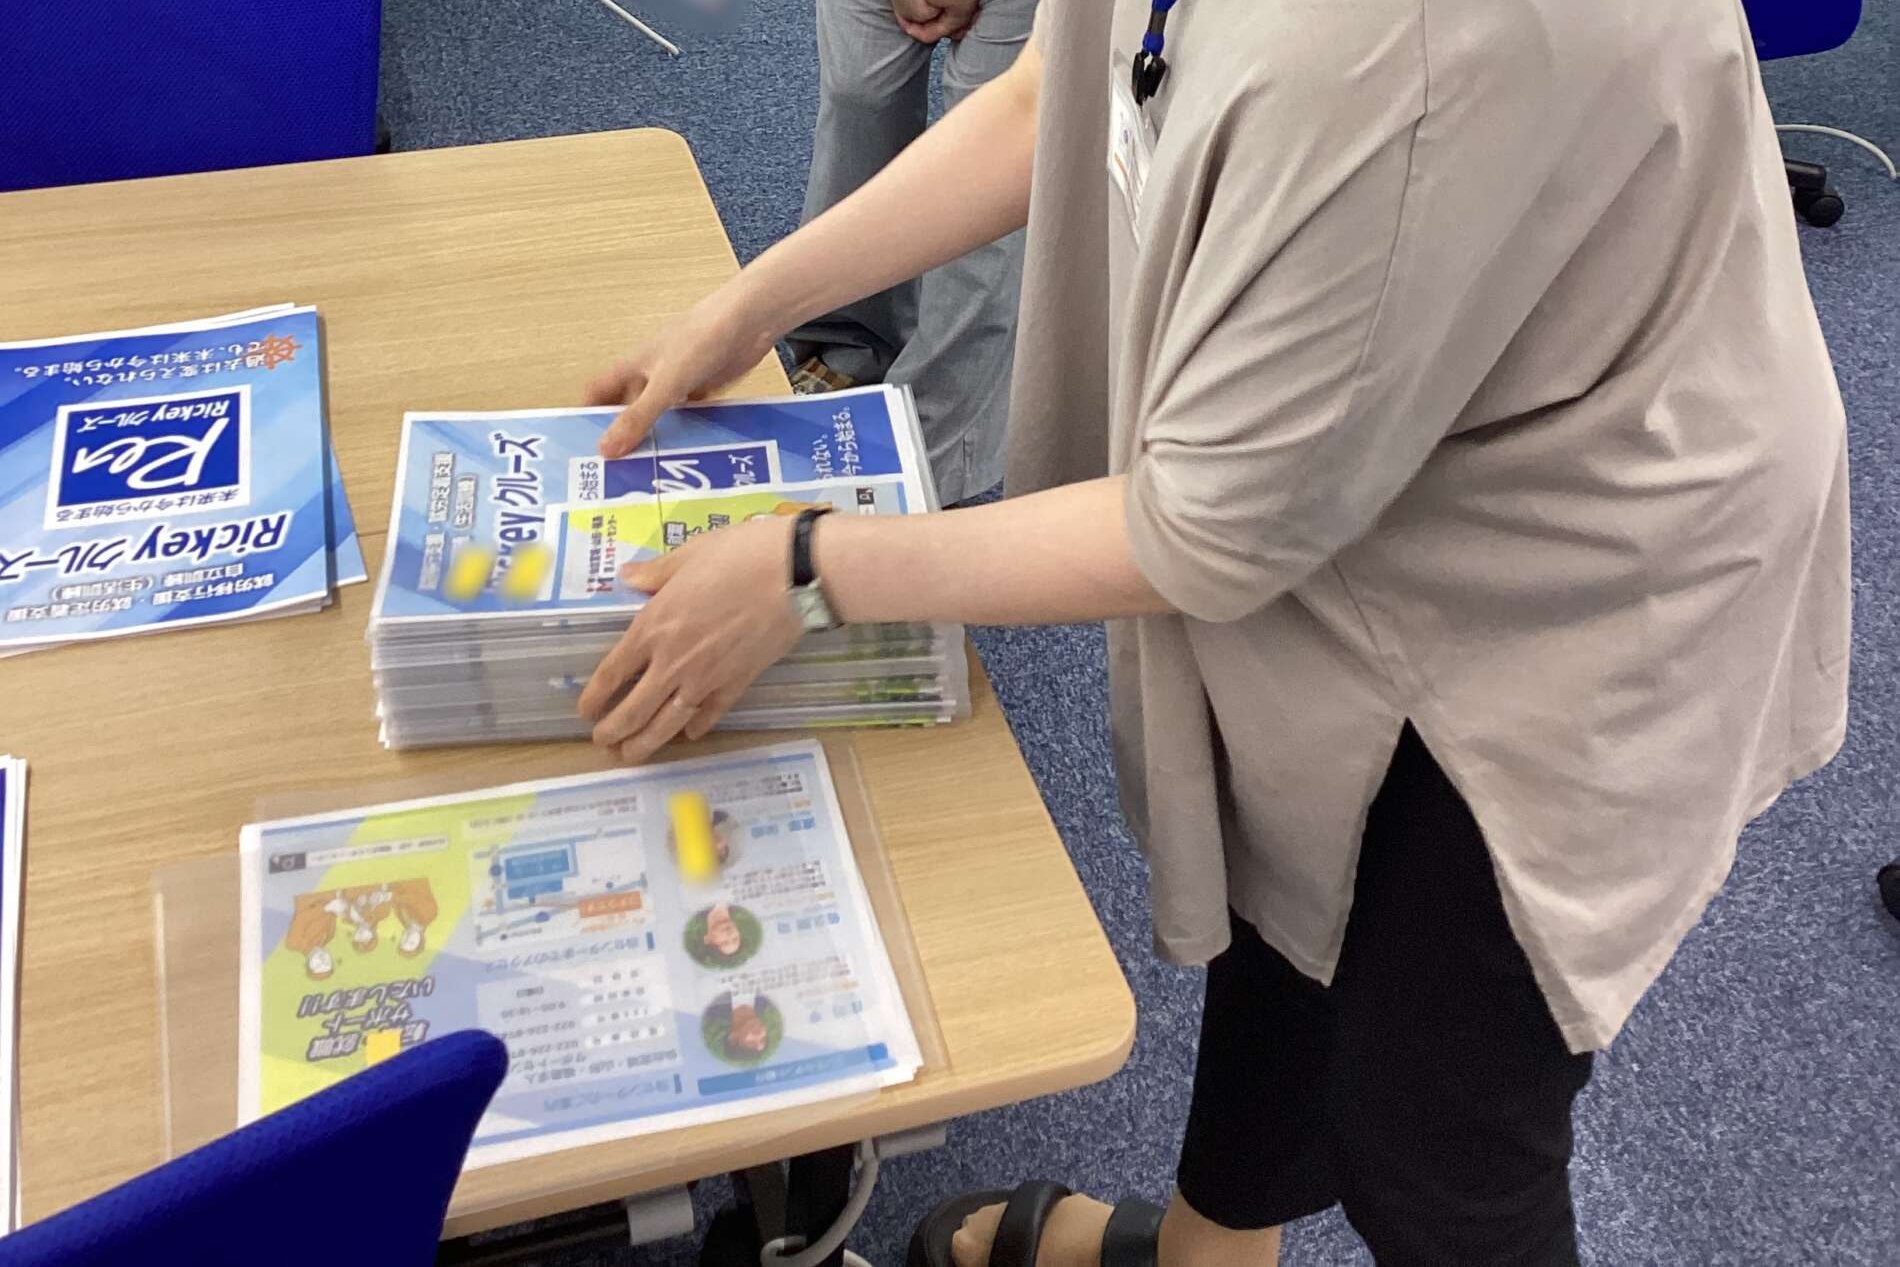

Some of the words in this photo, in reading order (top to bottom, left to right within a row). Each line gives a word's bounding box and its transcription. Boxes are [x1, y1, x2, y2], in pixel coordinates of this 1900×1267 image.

[14, 341, 264, 378] でも、未来は今から始まる。
[64, 354, 264, 387] 過去は変えられない。
[77, 409, 148, 433] クルーズ
[151, 400, 229, 423] Rickey
[493, 433, 542, 506] クルーズ
[55, 488, 239, 523] 未来は今から始まる
[132, 514, 287, 562] Rickey
[323, 1003, 410, 1032] サポート
